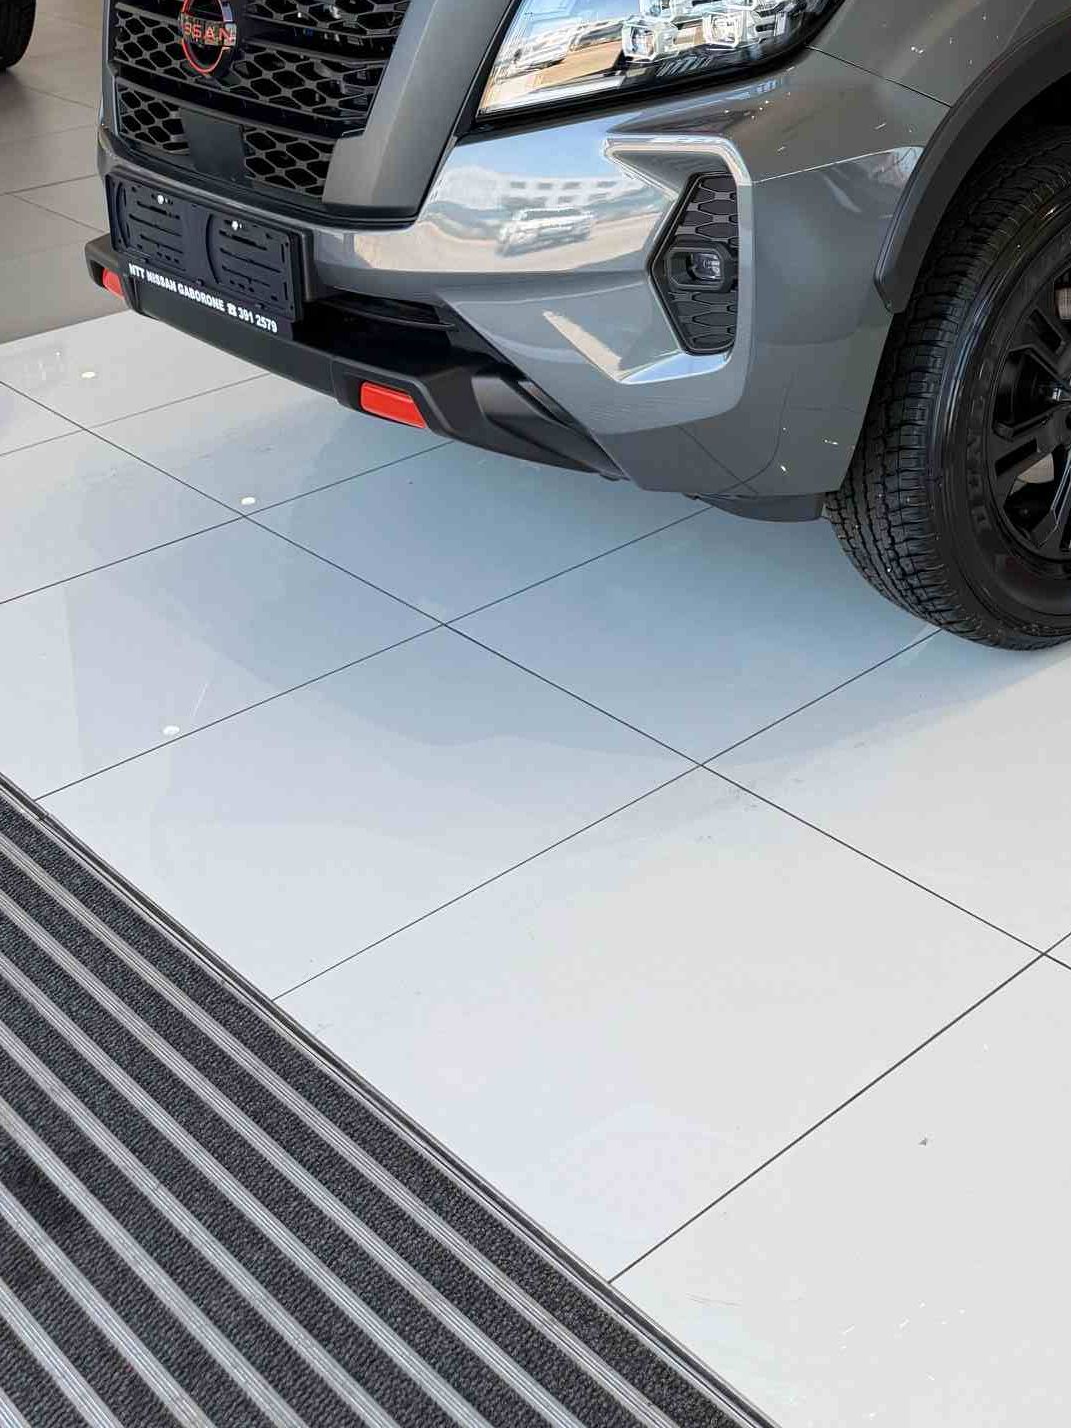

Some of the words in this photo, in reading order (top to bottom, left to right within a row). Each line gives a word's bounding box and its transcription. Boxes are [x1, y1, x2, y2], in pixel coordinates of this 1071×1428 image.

[146, 270, 177, 292] NISSAN
[177, 283, 226, 312] GABORONE
[237, 307, 254, 323] 391
[255, 314, 278, 333] 2579
